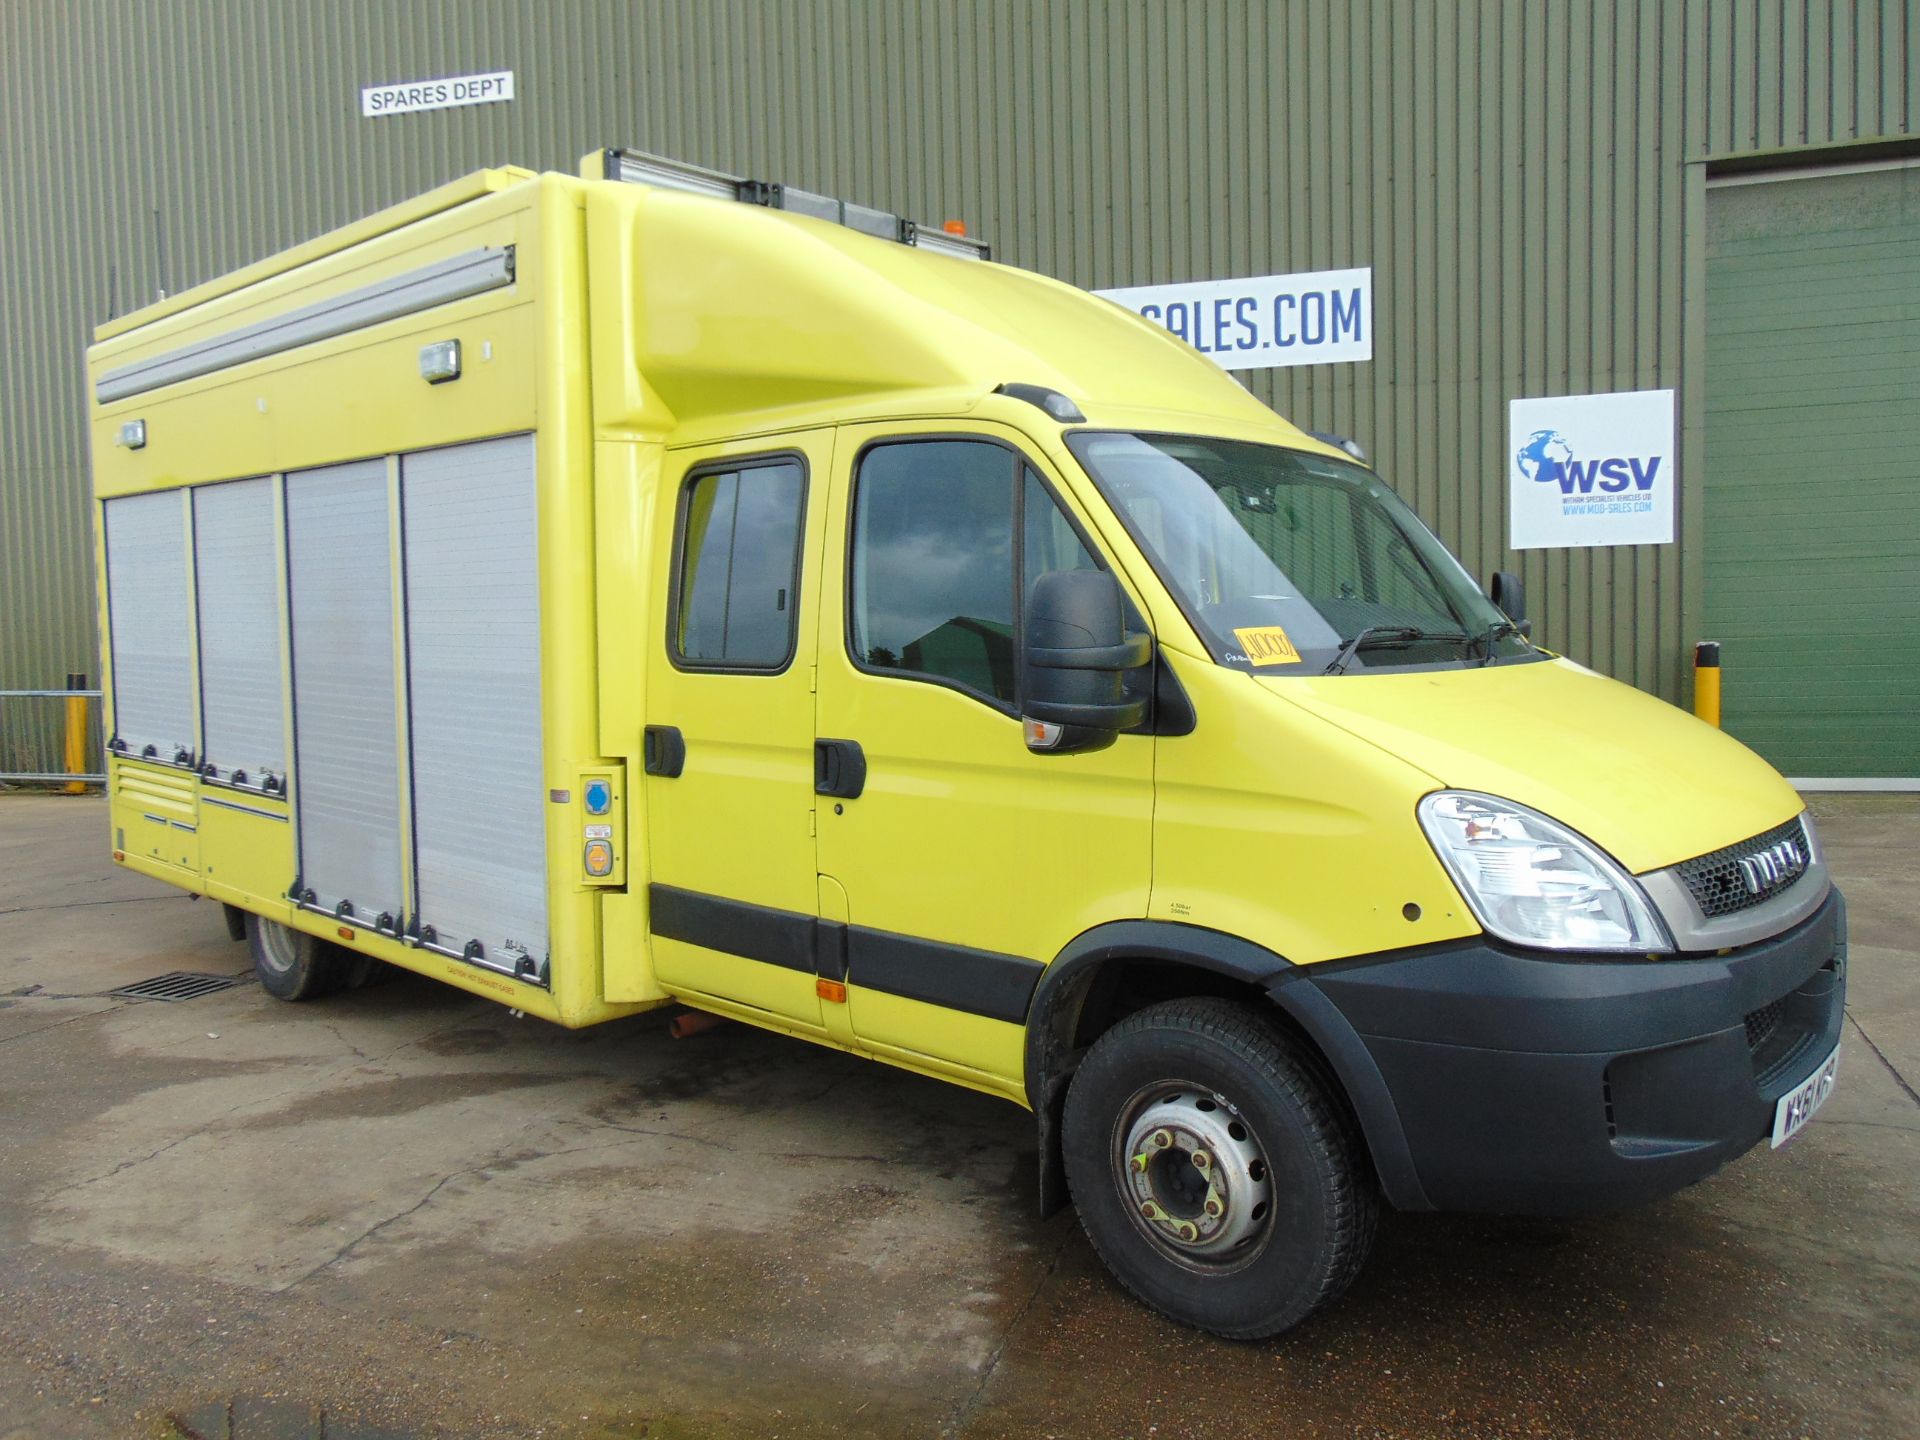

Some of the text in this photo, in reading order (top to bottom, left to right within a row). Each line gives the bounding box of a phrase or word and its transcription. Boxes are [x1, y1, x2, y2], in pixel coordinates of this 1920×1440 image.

[370, 77, 506, 111] SPARES DEPT
[1140, 287, 1362, 353] ALES.COM
[1554, 456, 1662, 494] WSV
